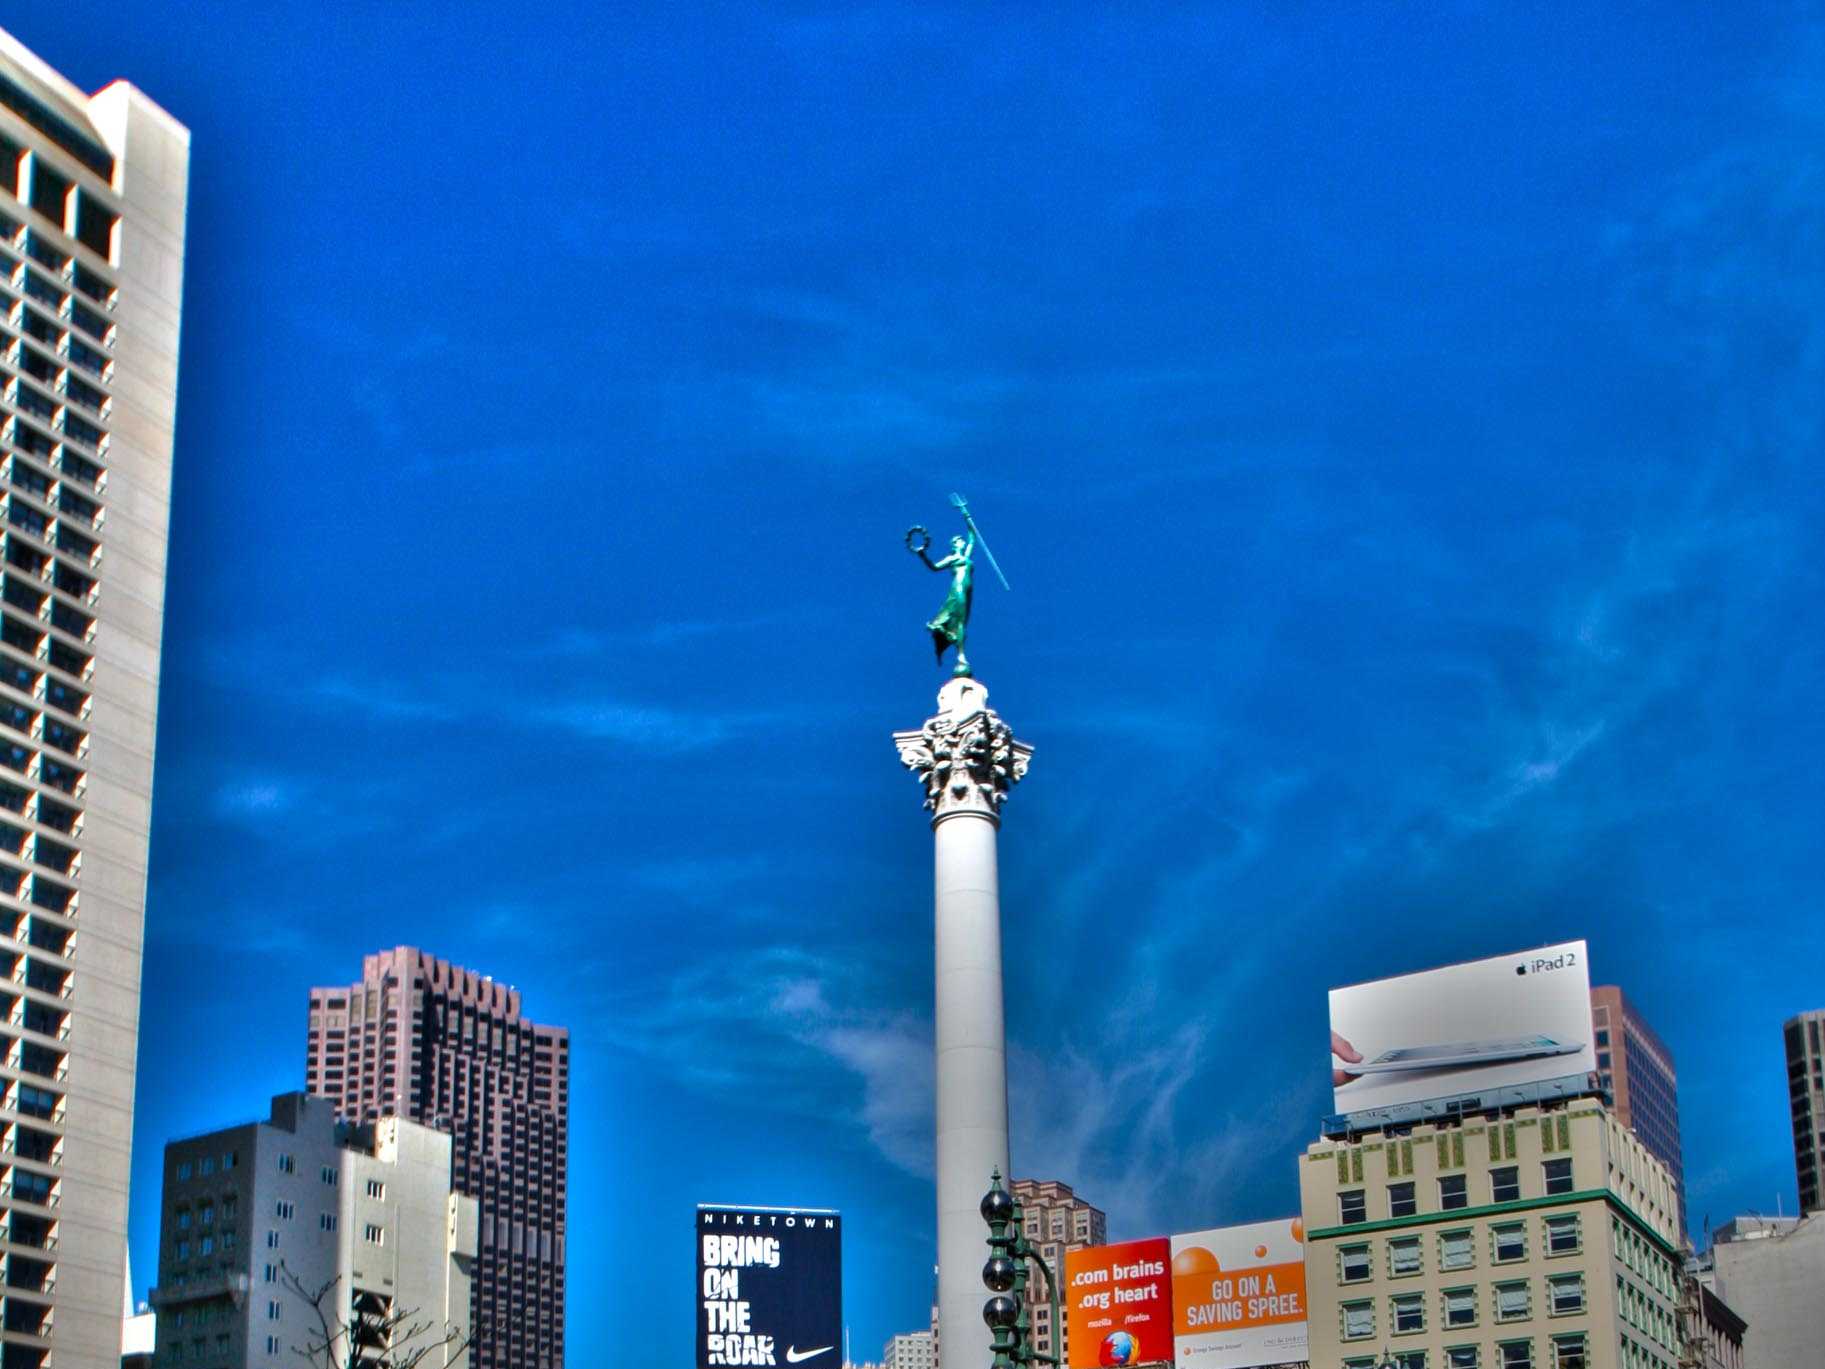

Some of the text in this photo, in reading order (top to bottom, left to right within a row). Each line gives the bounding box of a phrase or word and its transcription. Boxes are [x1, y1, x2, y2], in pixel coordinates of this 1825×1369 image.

[1531, 953, 1576, 973] iPad 2
[704, 1214, 834, 1229] NIKETOWN
[703, 1235, 780, 1268] BRING
[703, 1268, 739, 1299] ON
[1071, 1260, 1164, 1287] .com brains
[1212, 1273, 1276, 1300] GO ON A
[1078, 1282, 1158, 1309] .org heart
[1187, 1293, 1303, 1326] SAVING SPREE.
[704, 1301, 751, 1333] THE
[708, 1334, 776, 1366] ROAR
